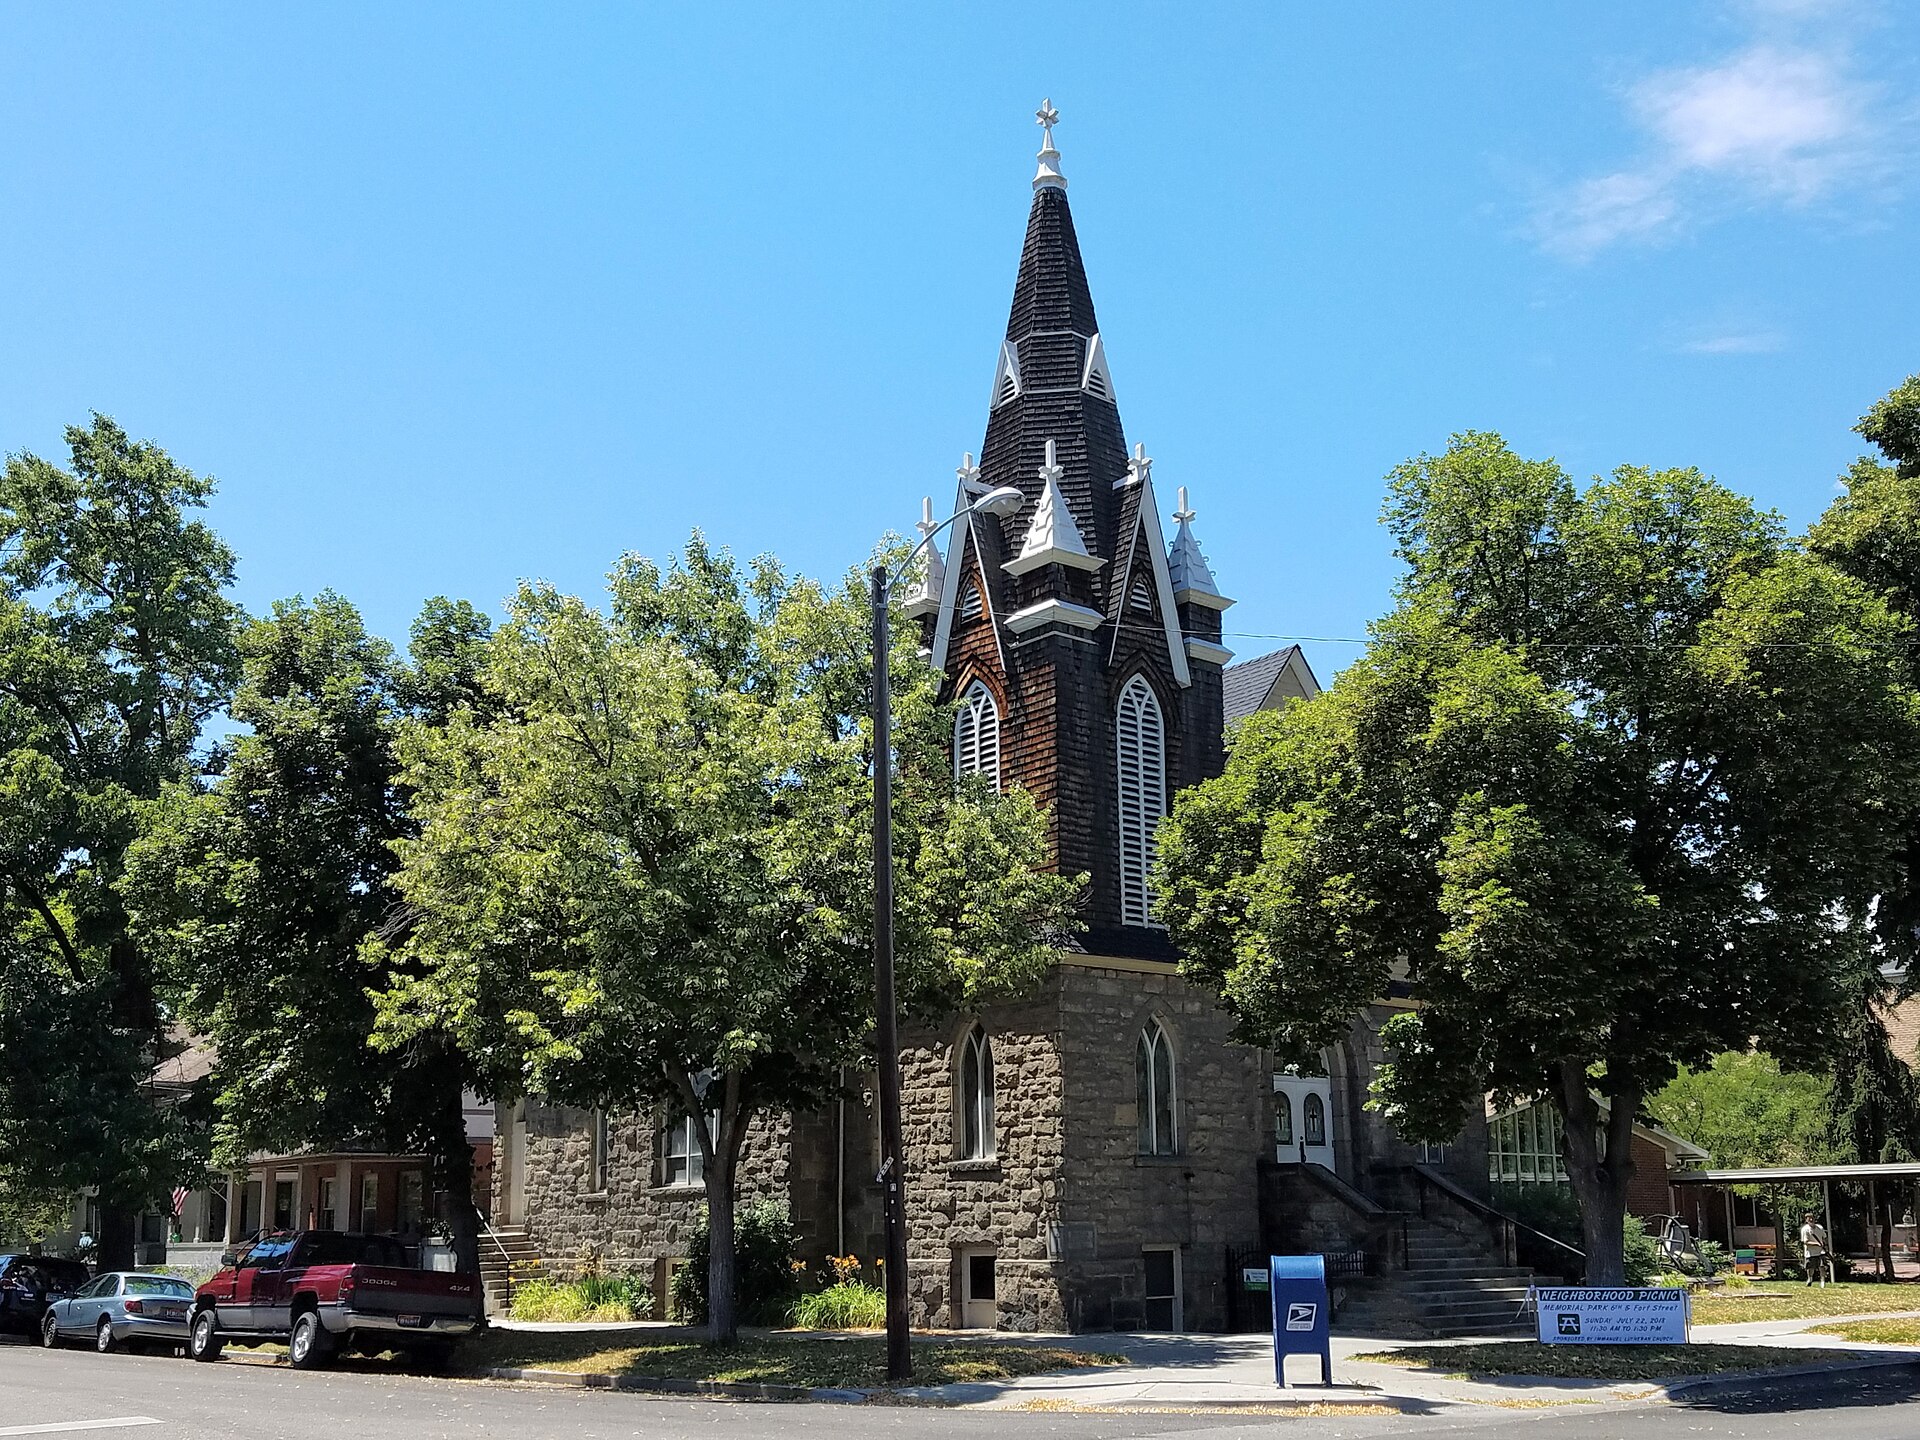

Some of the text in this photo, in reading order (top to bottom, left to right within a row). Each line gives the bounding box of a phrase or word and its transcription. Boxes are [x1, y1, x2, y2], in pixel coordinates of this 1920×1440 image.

[1541, 1290, 1678, 1301] NEIGHBORHOOD PICNIC
[1635, 1317, 1647, 1325] 22,
